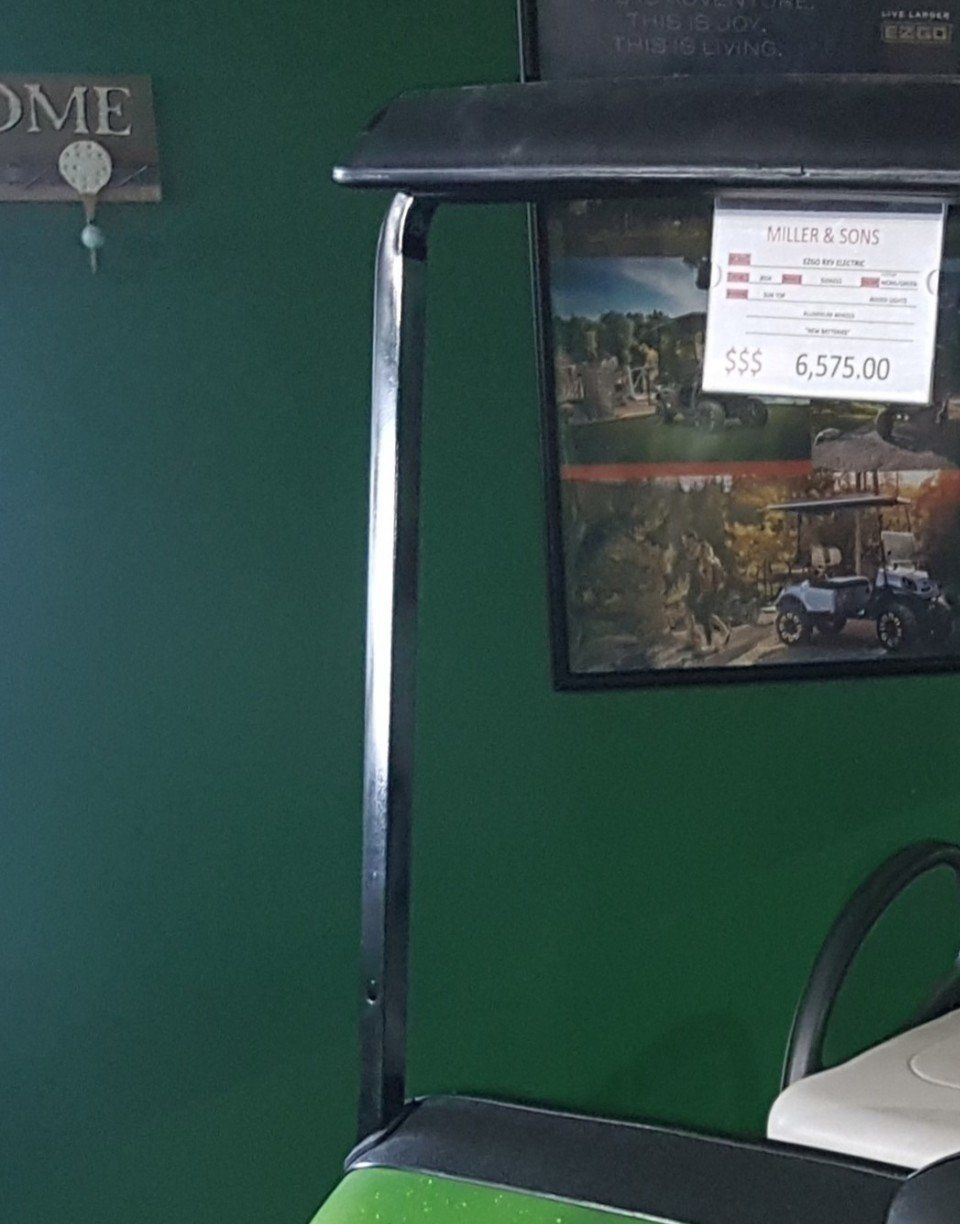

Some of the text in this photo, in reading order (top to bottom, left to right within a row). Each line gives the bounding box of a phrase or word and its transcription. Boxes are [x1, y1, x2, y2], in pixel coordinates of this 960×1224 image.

[626, 11, 681, 31] THIS
[689, 14, 710, 32] IS
[881, 10, 905, 19] LIVE
[614, 36, 783, 57] THIS IS LIVING.
[766, 226, 880, 246] MILLER & SONS
[836, 258, 866, 268] ELECTRIC
[725, 346, 891, 382] $$$ 6,575.00
